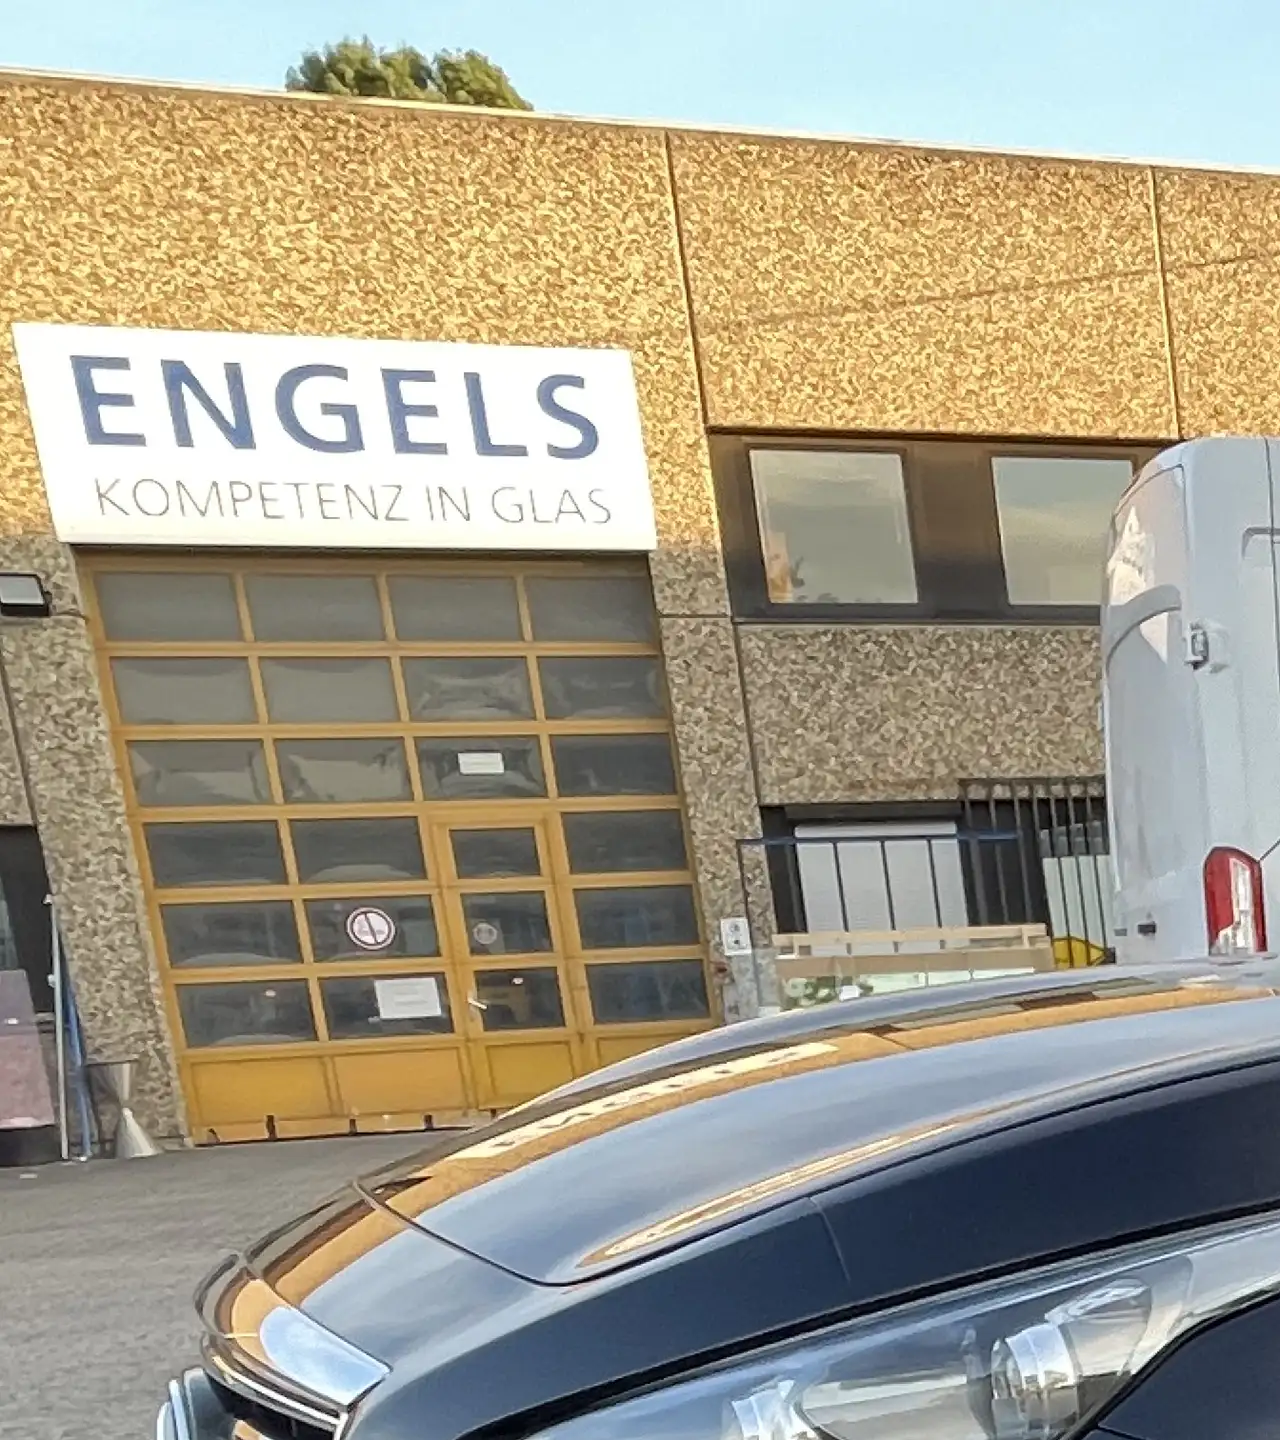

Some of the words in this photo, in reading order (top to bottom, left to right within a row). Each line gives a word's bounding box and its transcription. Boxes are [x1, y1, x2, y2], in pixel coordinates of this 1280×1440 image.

[69, 354, 600, 460] ENGELS
[94, 477, 409, 522] KOMPETENZ
[427, 484, 471, 523] IN
[490, 485, 612, 525] GLAS
